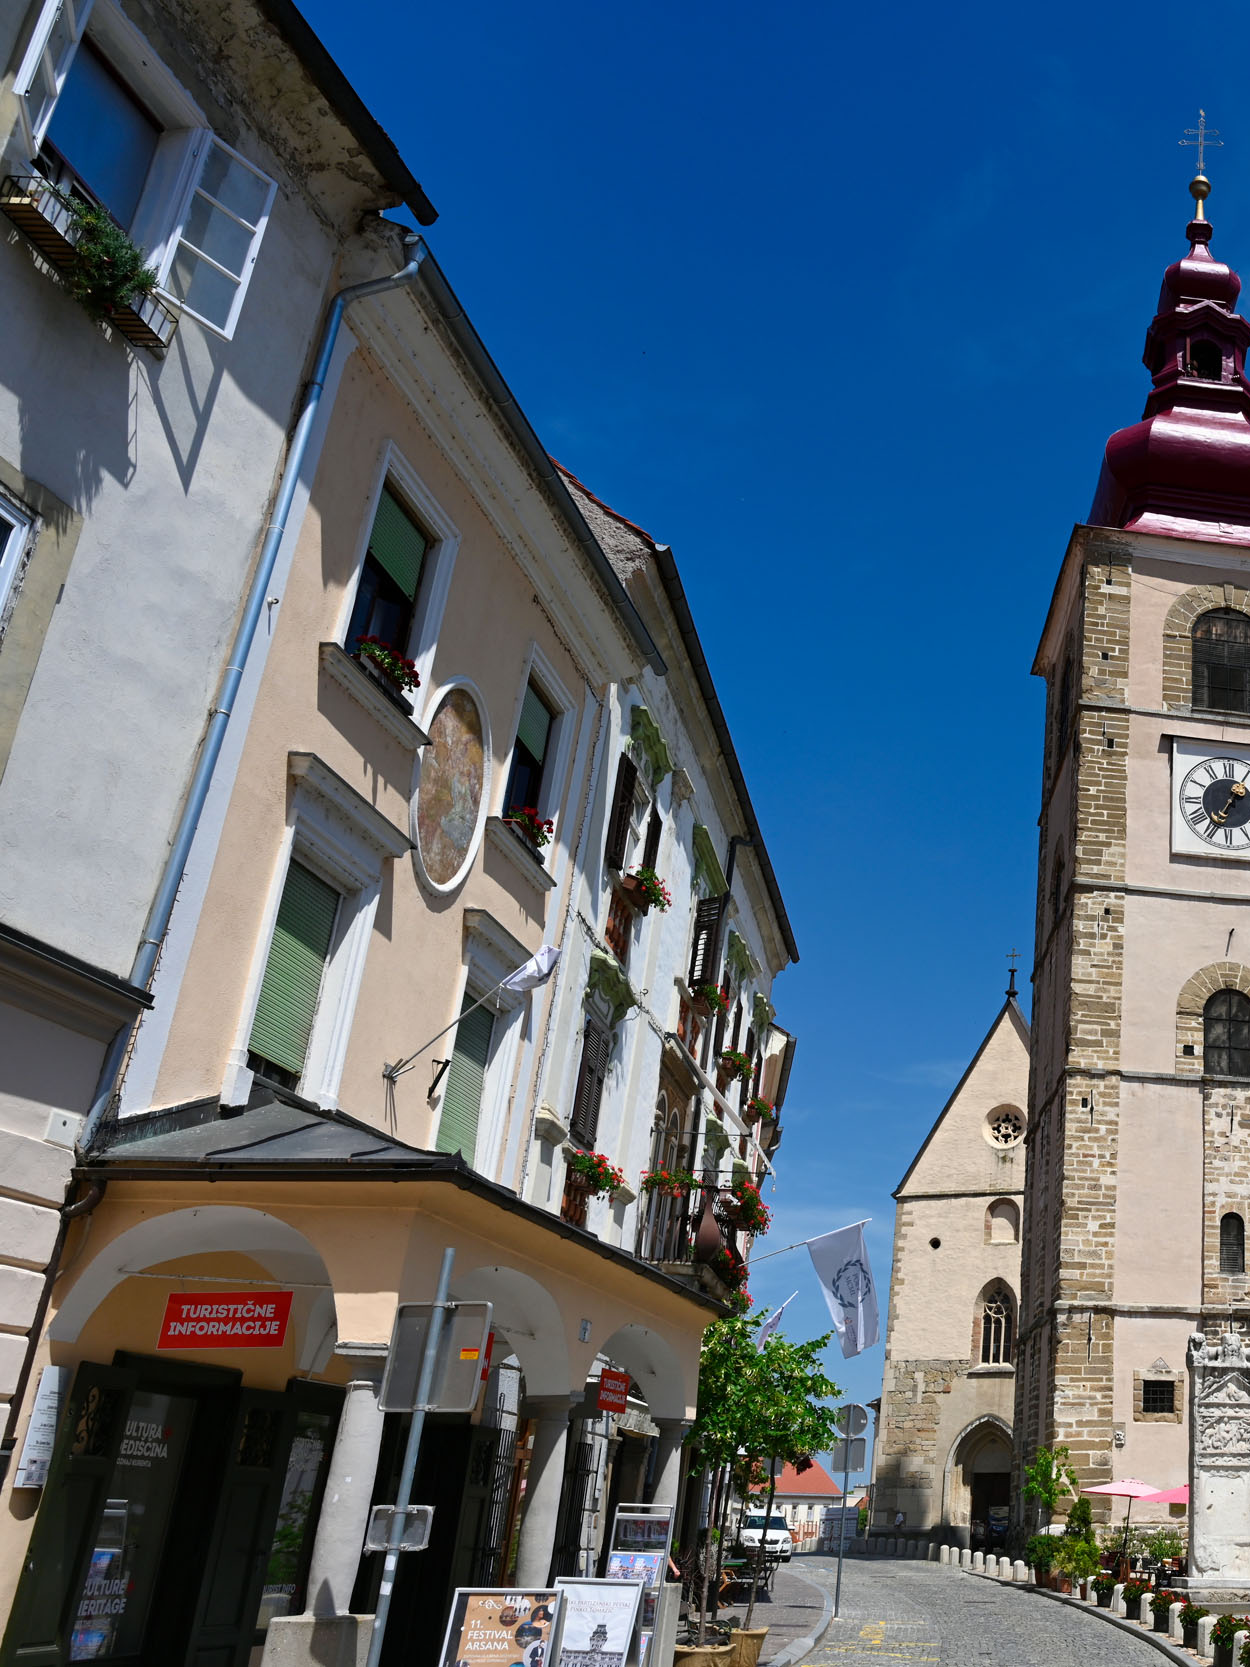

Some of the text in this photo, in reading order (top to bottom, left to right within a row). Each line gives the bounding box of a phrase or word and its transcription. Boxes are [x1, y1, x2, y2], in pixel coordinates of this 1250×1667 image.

[181, 1301, 276, 1318] TURISTIČNE
[168, 1321, 280, 1335] INFORMACIJE
[124, 1421, 161, 1439] ULTURA
[83, 1579, 125, 1596] ULTURE
[471, 1620, 484, 1628] 11.
[468, 1630, 513, 1640] FESTIVAL
[465, 1641, 508, 1651] ARSANA
